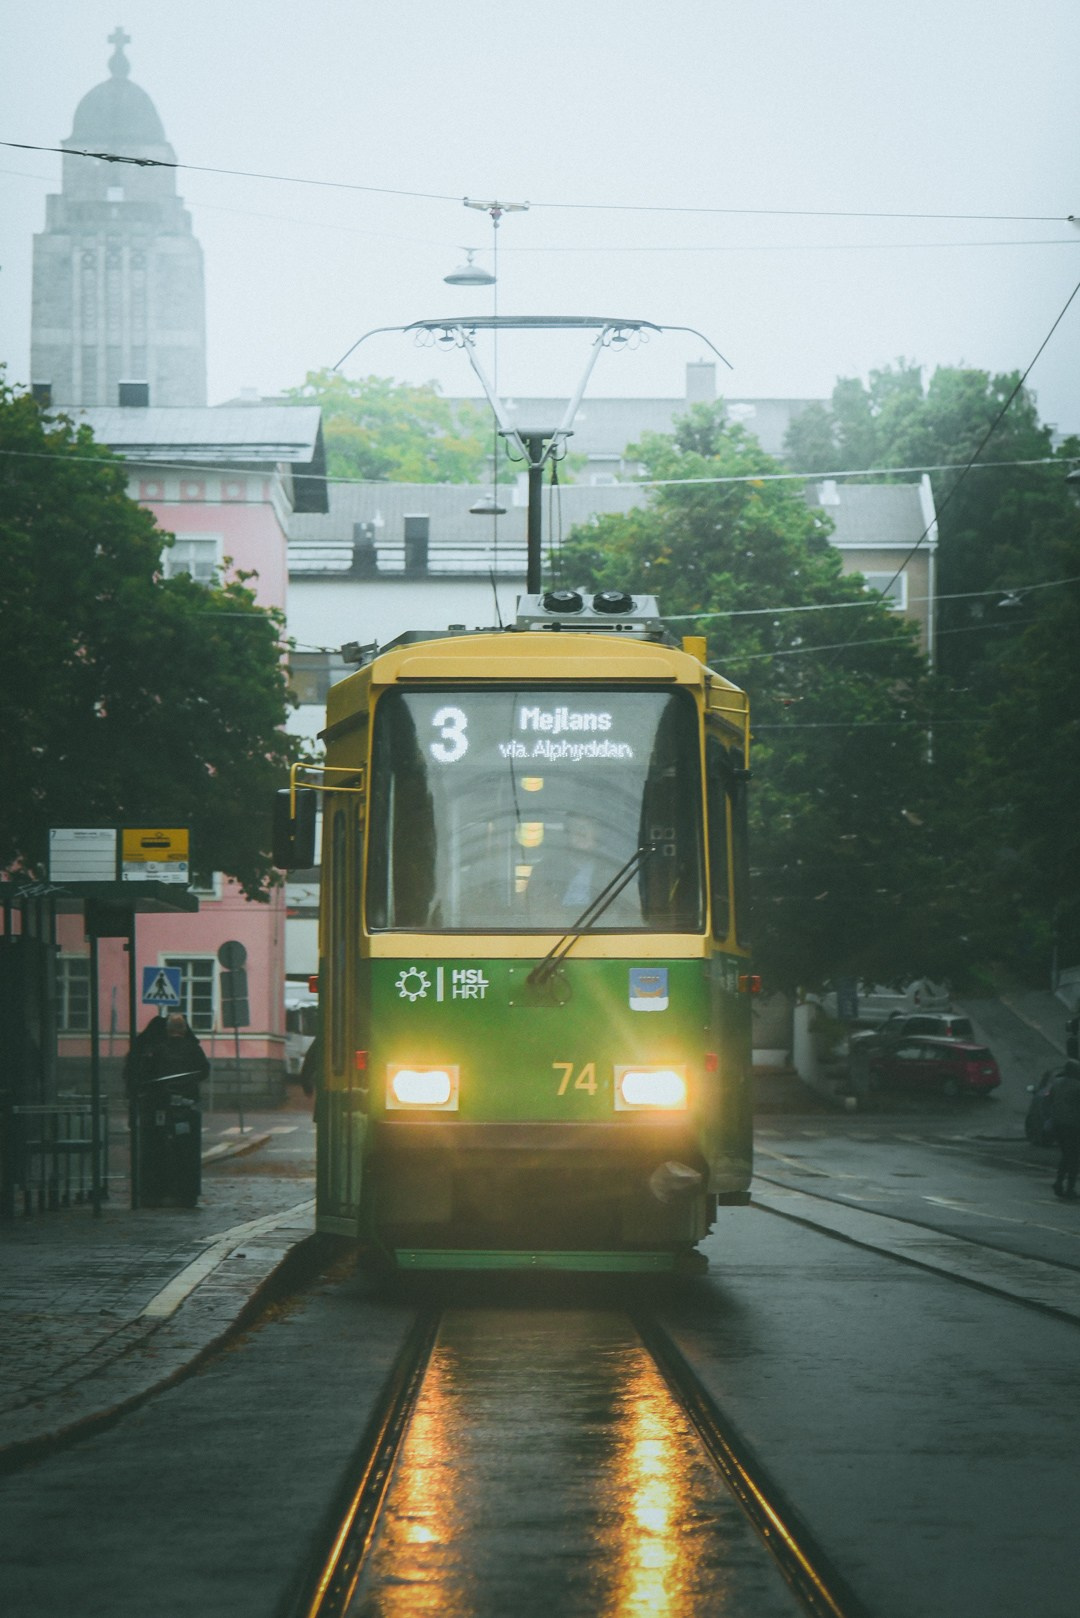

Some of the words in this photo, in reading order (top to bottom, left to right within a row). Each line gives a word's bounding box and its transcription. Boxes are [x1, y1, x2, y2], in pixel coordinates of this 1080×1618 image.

[520, 706, 612, 733] Mejlans
[431, 707, 469, 762] 3
[452, 969, 489, 984] HSL
[452, 984, 489, 999] HRT
[552, 1062, 598, 1096] 74
